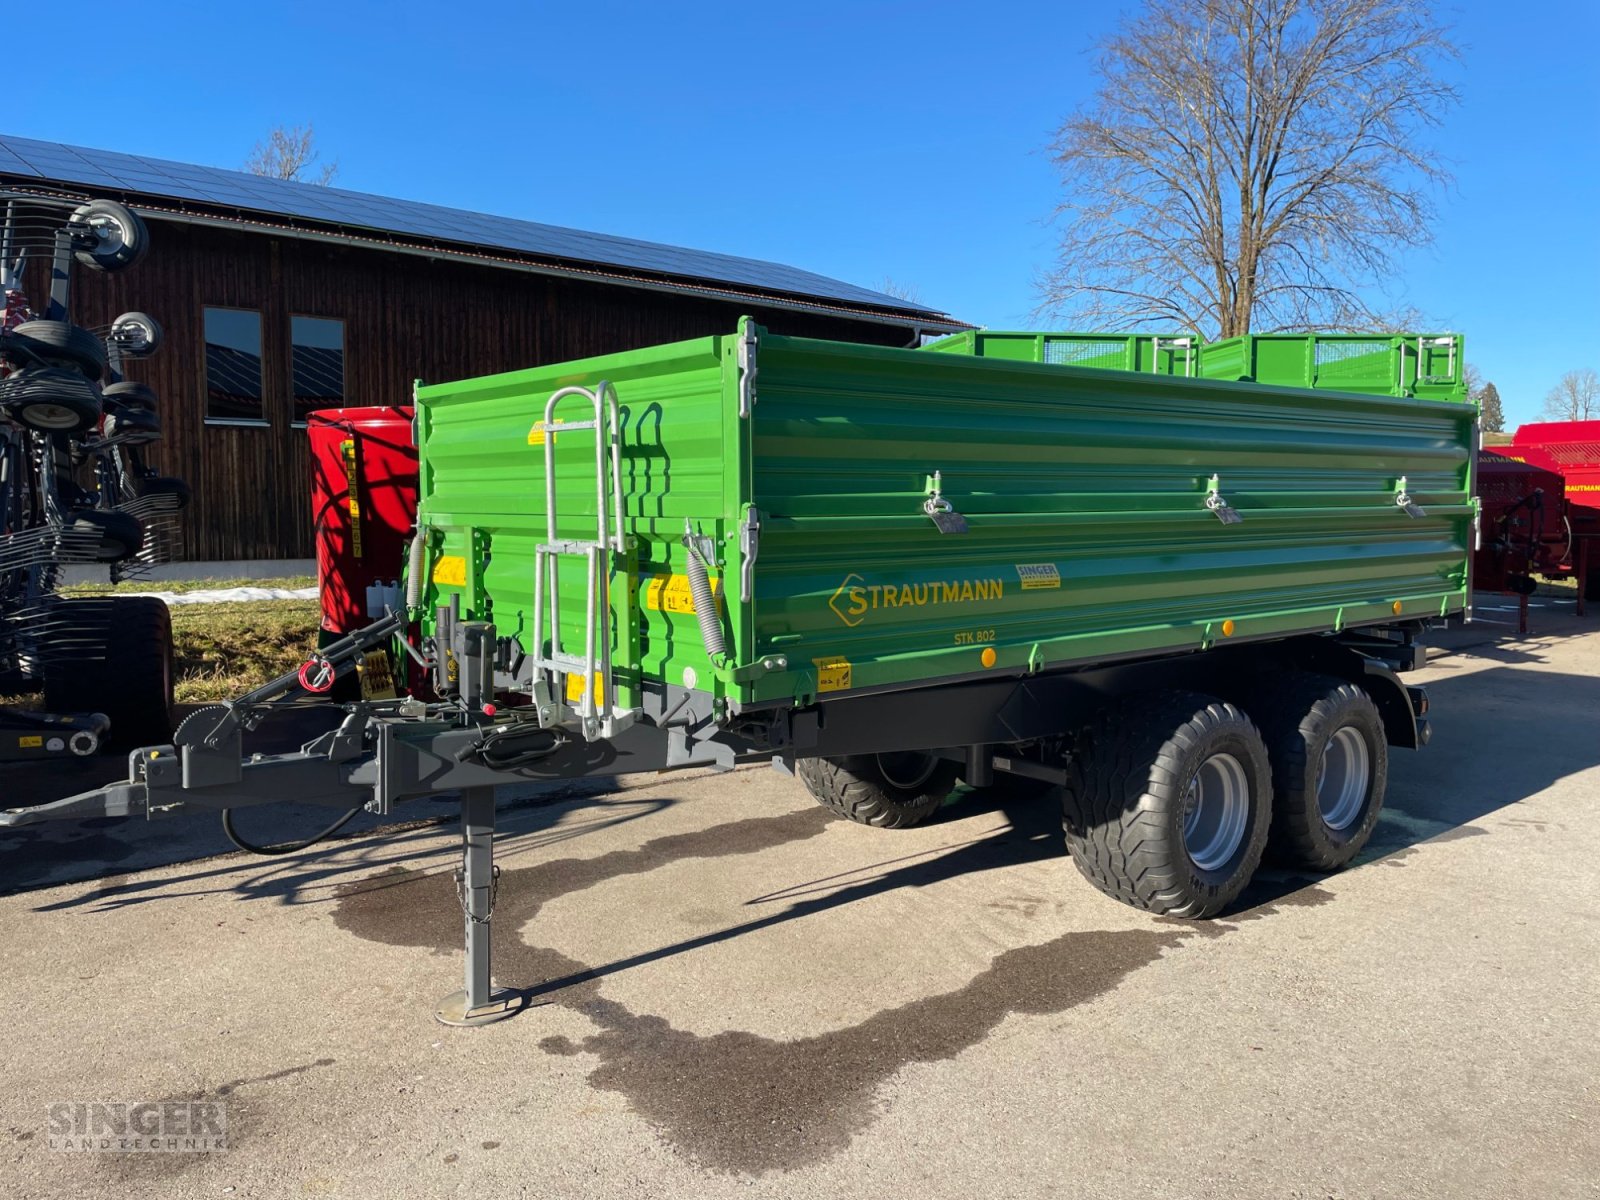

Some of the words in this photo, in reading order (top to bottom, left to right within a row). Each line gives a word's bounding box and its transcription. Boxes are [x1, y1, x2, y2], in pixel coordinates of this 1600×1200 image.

[1018, 564, 1057, 576] SINGER
[848, 578, 1003, 615] STRAUTMANN
[954, 633, 974, 645] STK
[976, 630, 996, 642] 802
